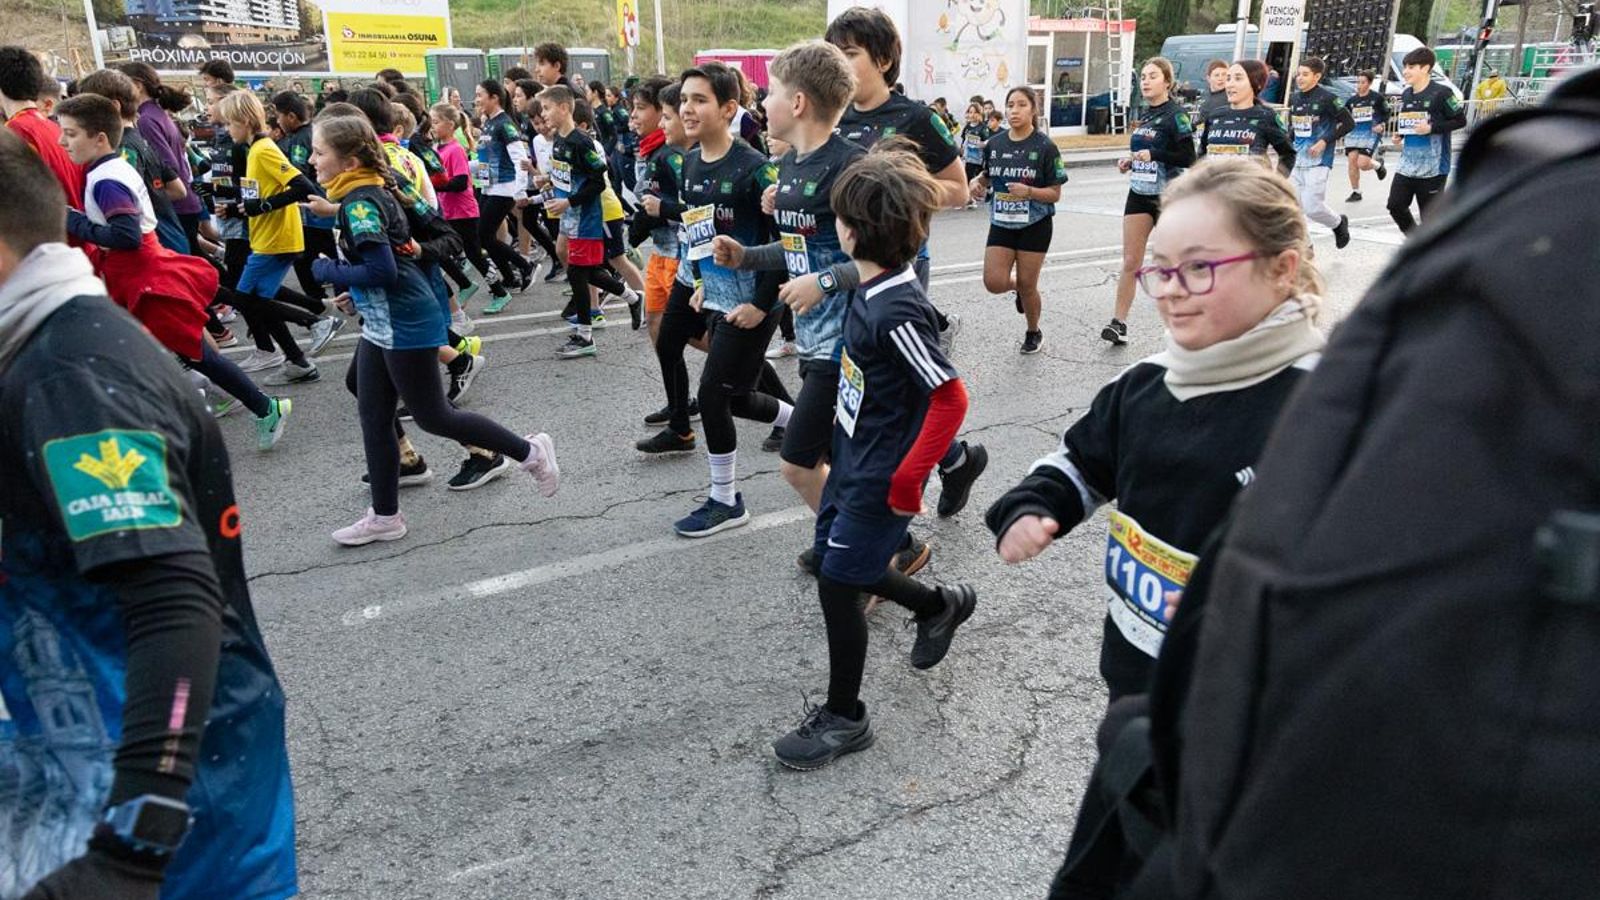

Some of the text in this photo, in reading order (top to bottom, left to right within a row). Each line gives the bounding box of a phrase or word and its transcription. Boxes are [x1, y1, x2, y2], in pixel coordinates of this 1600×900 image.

[1264, 5, 1300, 15] ATENCIÓN
[1268, 16, 1296, 26] MEDIOS
[407, 33, 438, 41] OSUNA
[129, 46, 306, 65] PRÓXIMA PROMOCIÓN
[1222, 129, 1256, 139] ANTÓN
[1003, 166, 1037, 178] ANTÓN
[67, 494, 112, 515] CAJA
